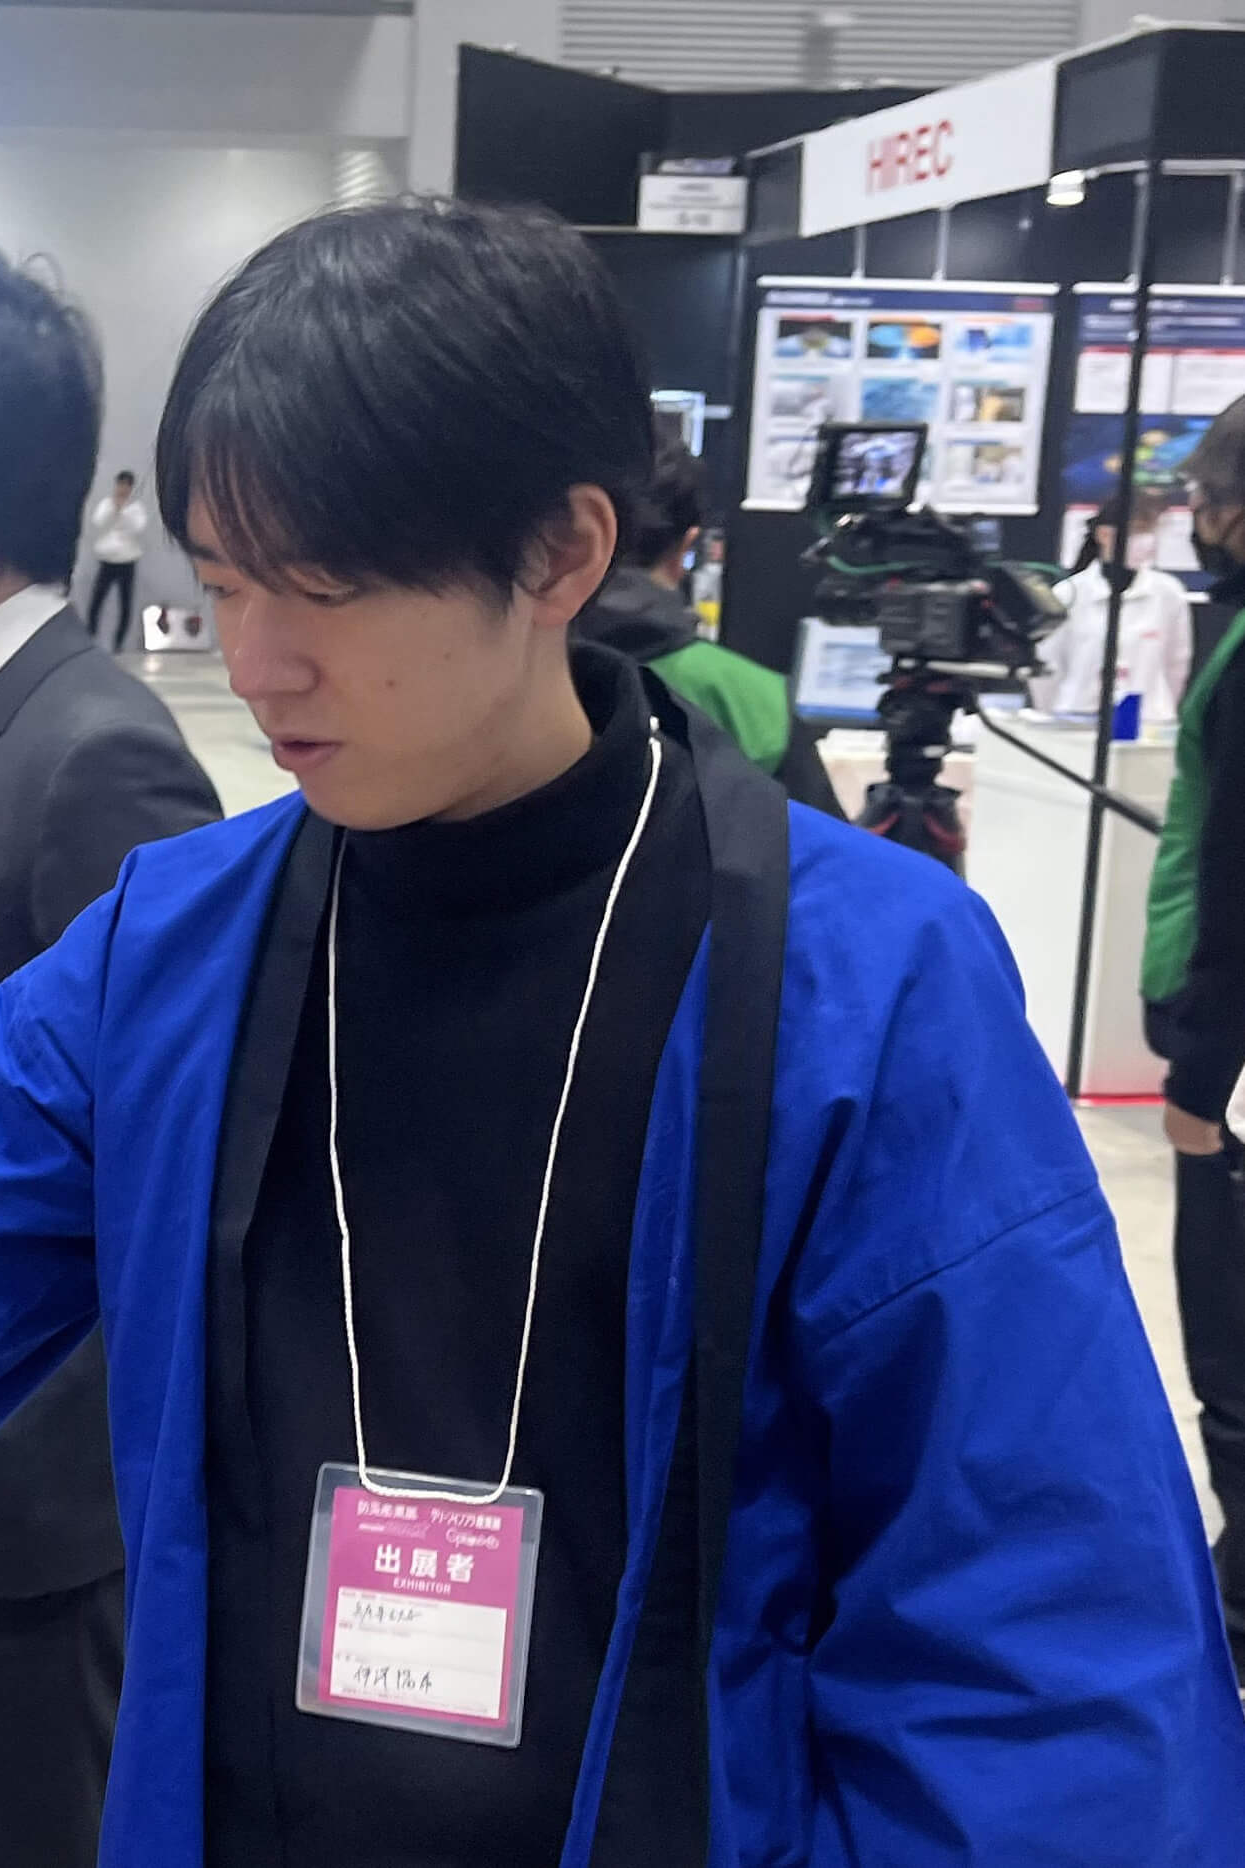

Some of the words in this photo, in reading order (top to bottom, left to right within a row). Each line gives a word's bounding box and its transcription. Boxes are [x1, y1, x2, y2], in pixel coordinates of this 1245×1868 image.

[866, 118, 955, 194] HIREC
[374, 1543, 474, 1584] 出展者
[392, 1576, 452, 1595] EXHIBITOR
